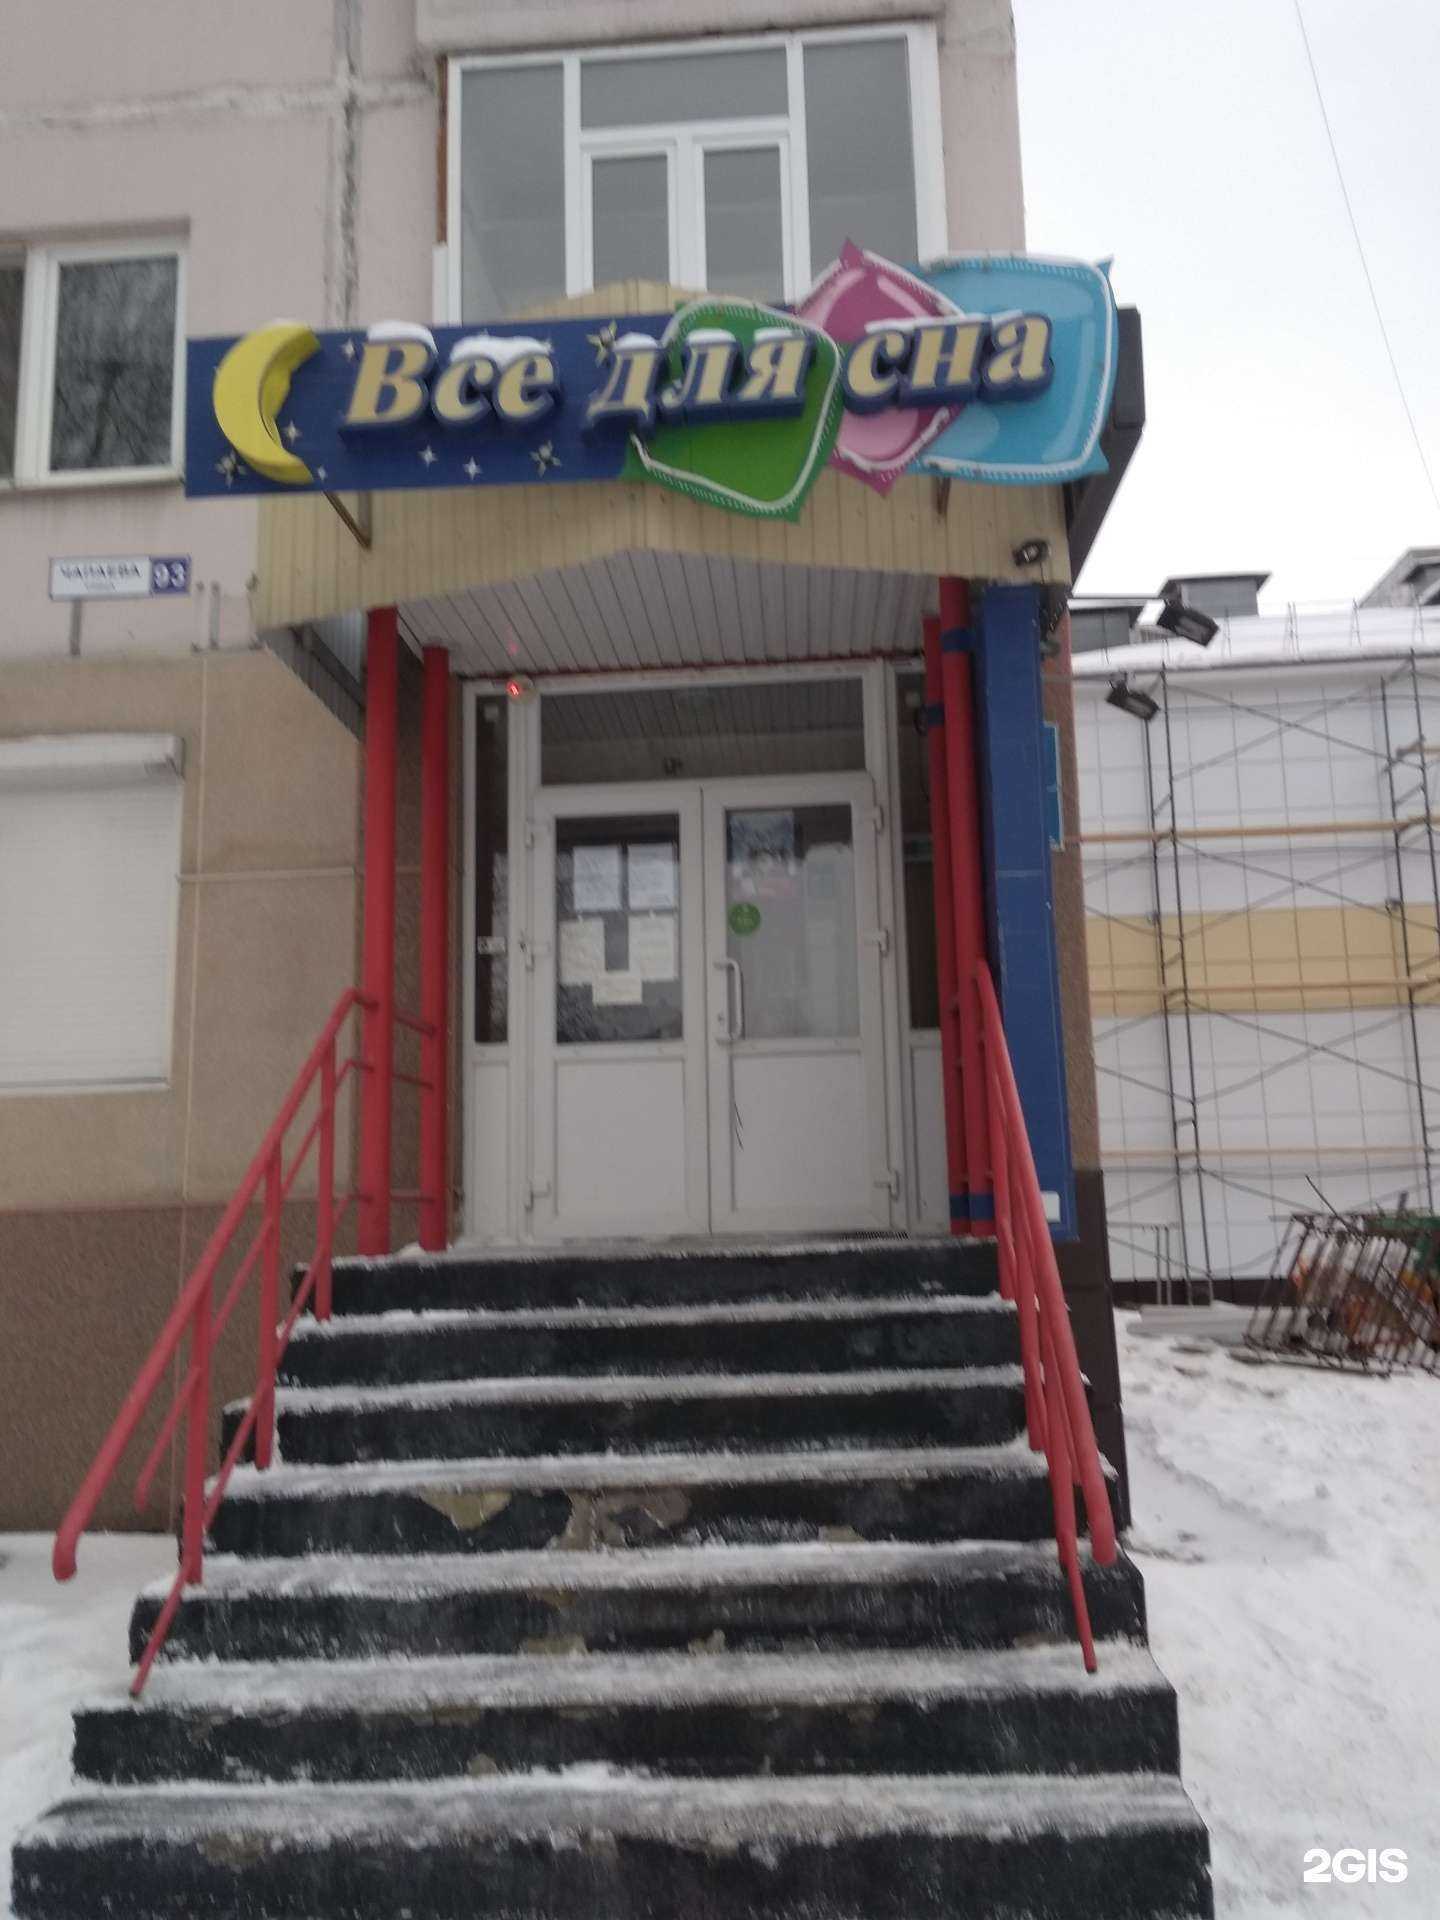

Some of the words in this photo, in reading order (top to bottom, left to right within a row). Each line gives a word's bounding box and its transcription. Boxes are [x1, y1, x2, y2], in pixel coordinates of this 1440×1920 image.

[342, 336, 556, 427] Все
[583, 333, 809, 426] для
[845, 315, 1053, 403] сна
